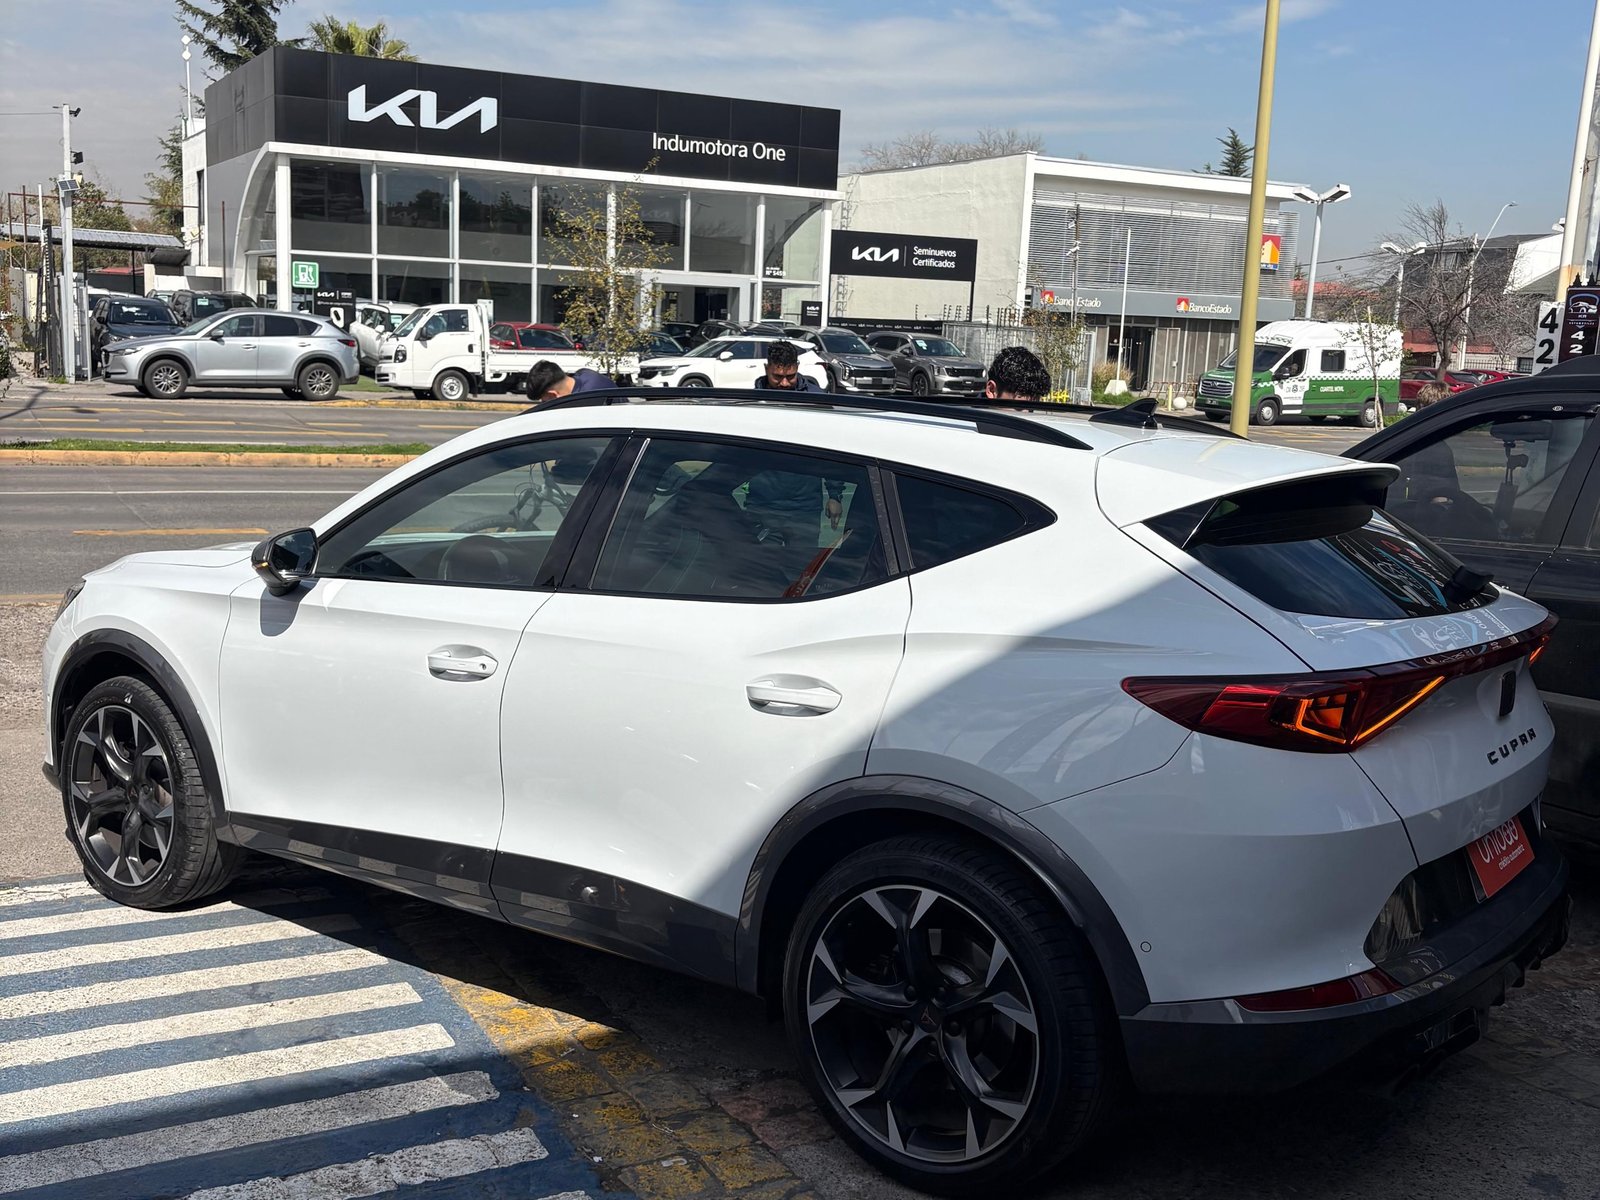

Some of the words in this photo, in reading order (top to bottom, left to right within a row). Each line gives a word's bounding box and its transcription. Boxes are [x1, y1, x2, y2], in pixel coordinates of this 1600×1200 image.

[348, 84, 498, 133] KIA
[653, 132, 748, 158] Indumotora
[752, 142, 786, 161] One
[851, 246, 899, 262] KIA
[913, 246, 957, 258] Seminuevos
[912, 257, 956, 269] Certificados
[1188, 302, 1232, 314] BancoEstado
[1486, 728, 1536, 765] CUPRA
